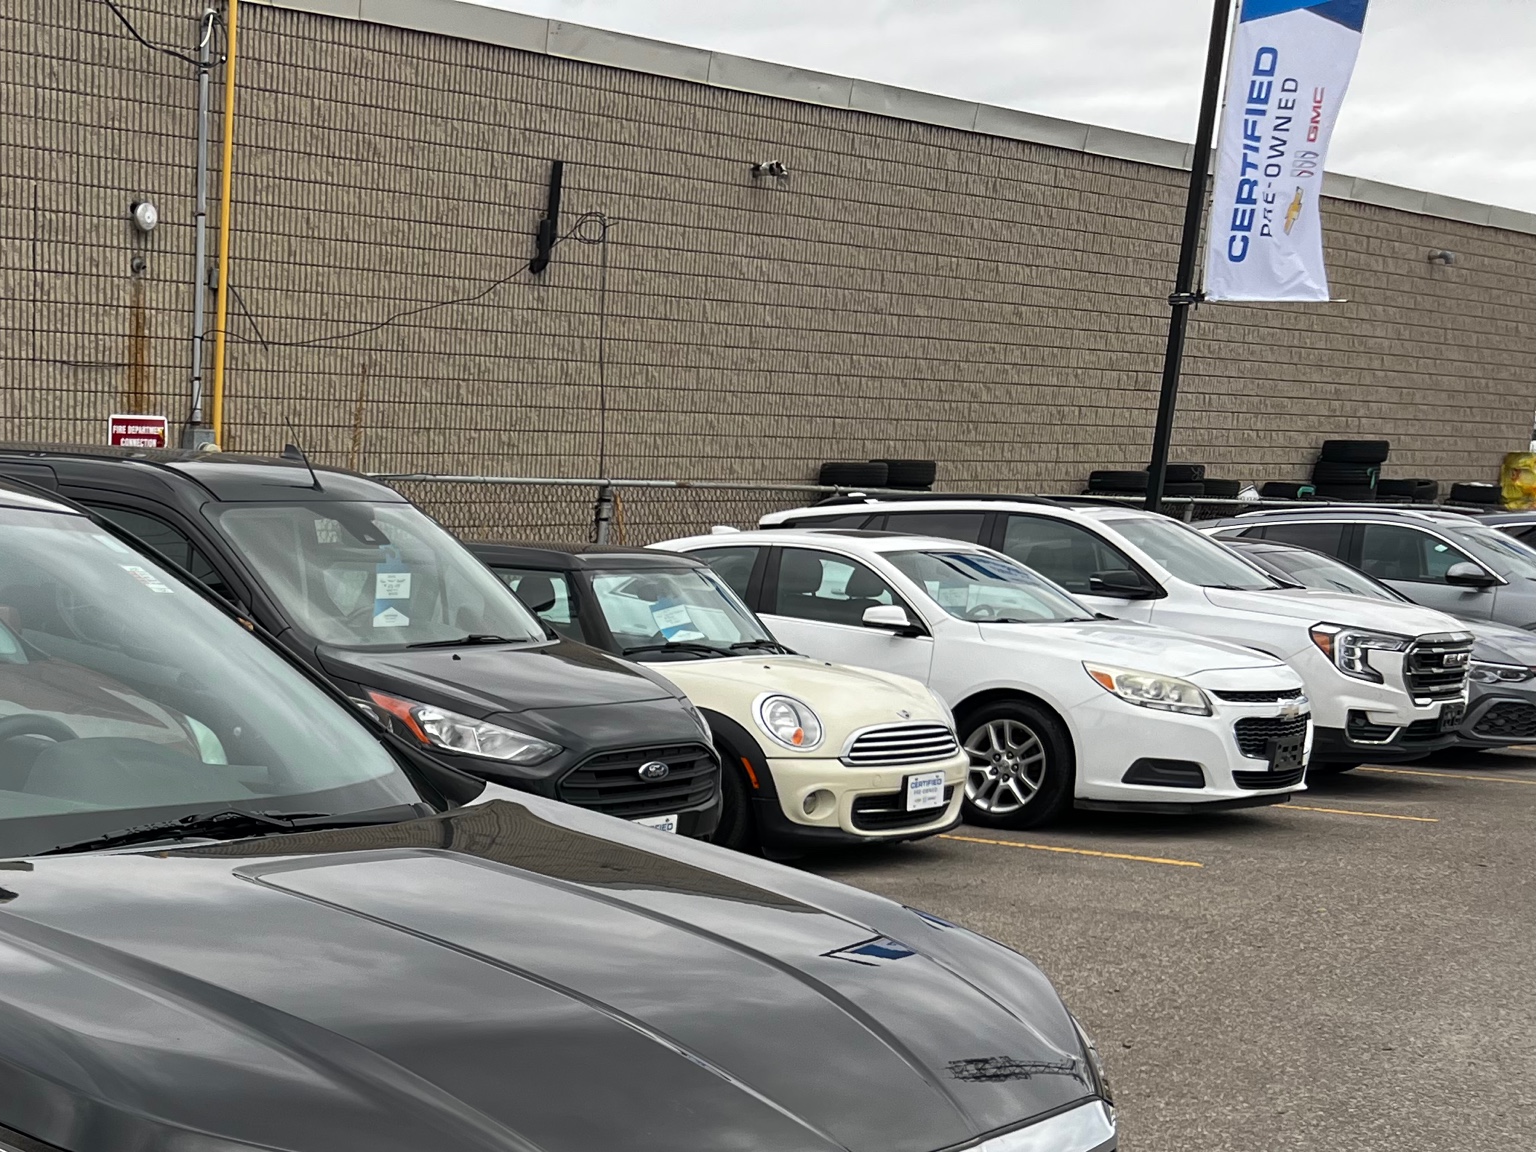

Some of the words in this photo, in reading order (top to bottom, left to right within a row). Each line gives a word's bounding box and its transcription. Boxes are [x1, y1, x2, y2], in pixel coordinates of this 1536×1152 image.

[1306, 86, 1325, 143] GMC
[1227, 46, 1279, 263] CERTIFIED
[1259, 77, 1299, 238] PRE-OWNED
[112, 425, 127, 434] FIRE
[120, 437, 157, 448] CONNECTION
[910, 778, 943, 789] CERTIFIED
